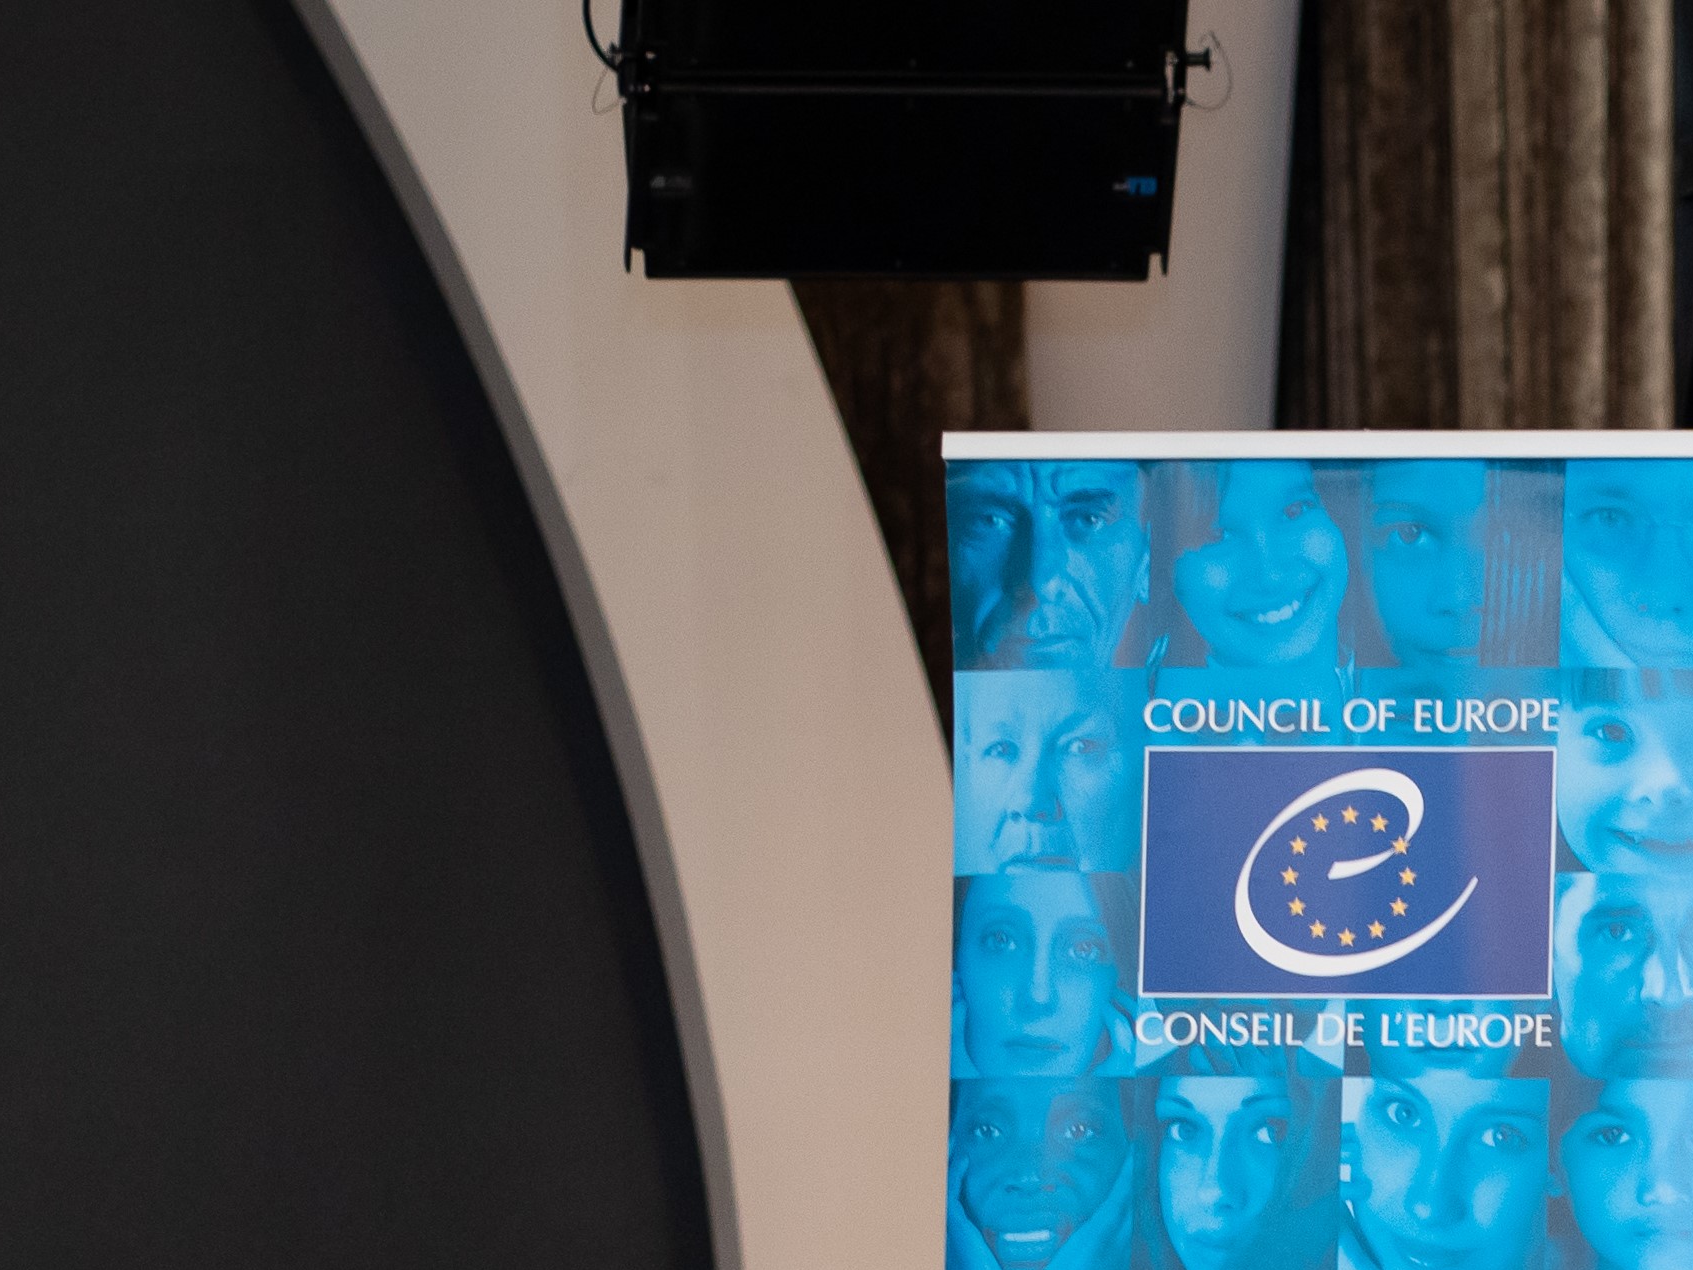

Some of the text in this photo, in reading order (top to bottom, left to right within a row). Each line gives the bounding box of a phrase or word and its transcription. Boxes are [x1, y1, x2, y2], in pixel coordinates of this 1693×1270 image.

[1143, 697, 1560, 734] COUNCIL OF EUROPE
[1134, 1011, 1553, 1048] CONSEIL DE L'EUROPE
